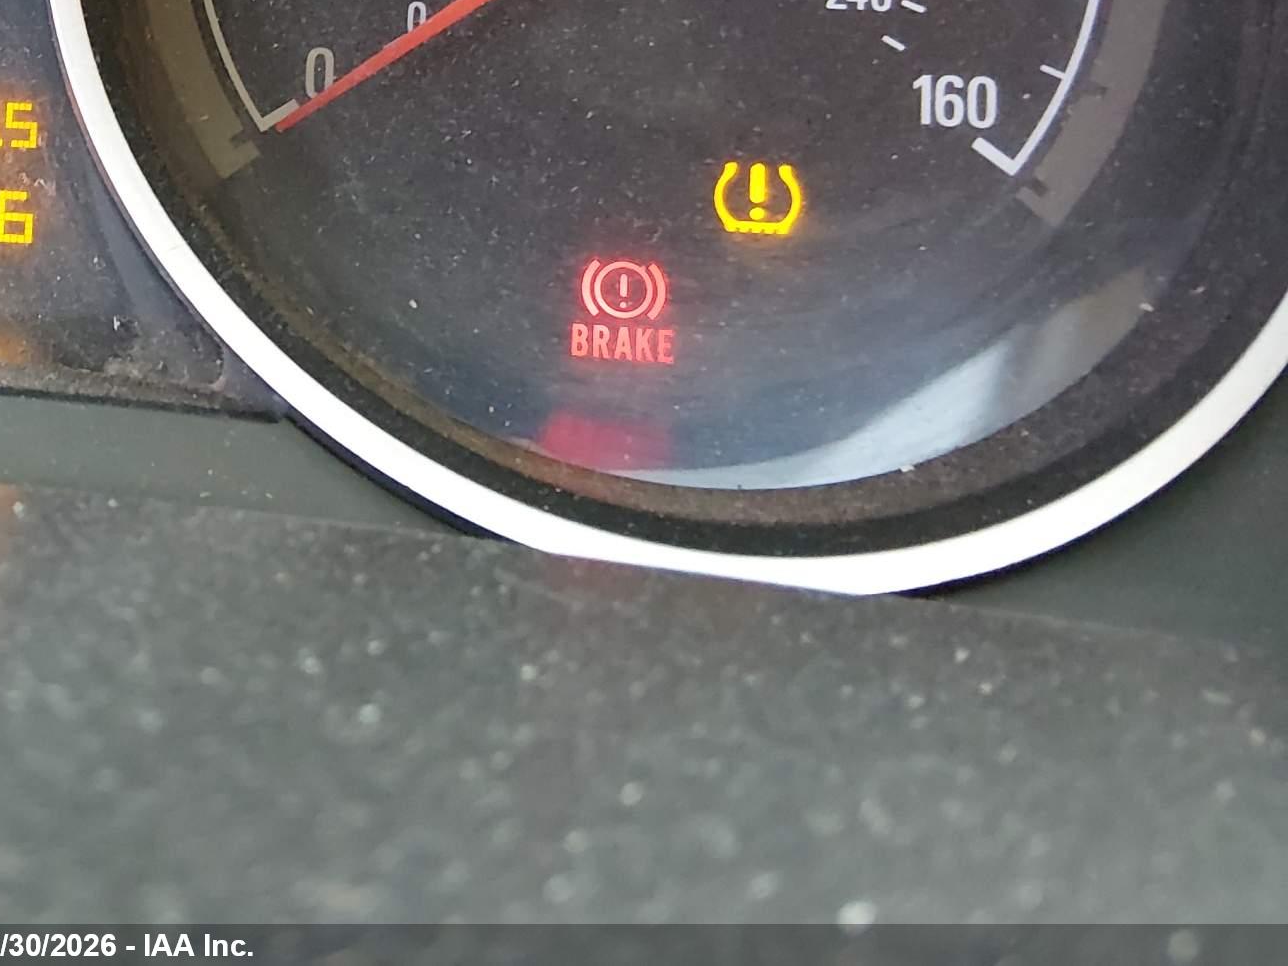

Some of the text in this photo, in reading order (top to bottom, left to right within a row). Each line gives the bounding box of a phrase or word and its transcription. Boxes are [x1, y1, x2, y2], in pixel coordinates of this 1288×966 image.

[305, 47, 335, 99] 0
[913, 75, 997, 129] 160
[571, 322, 675, 365] BRAKE
